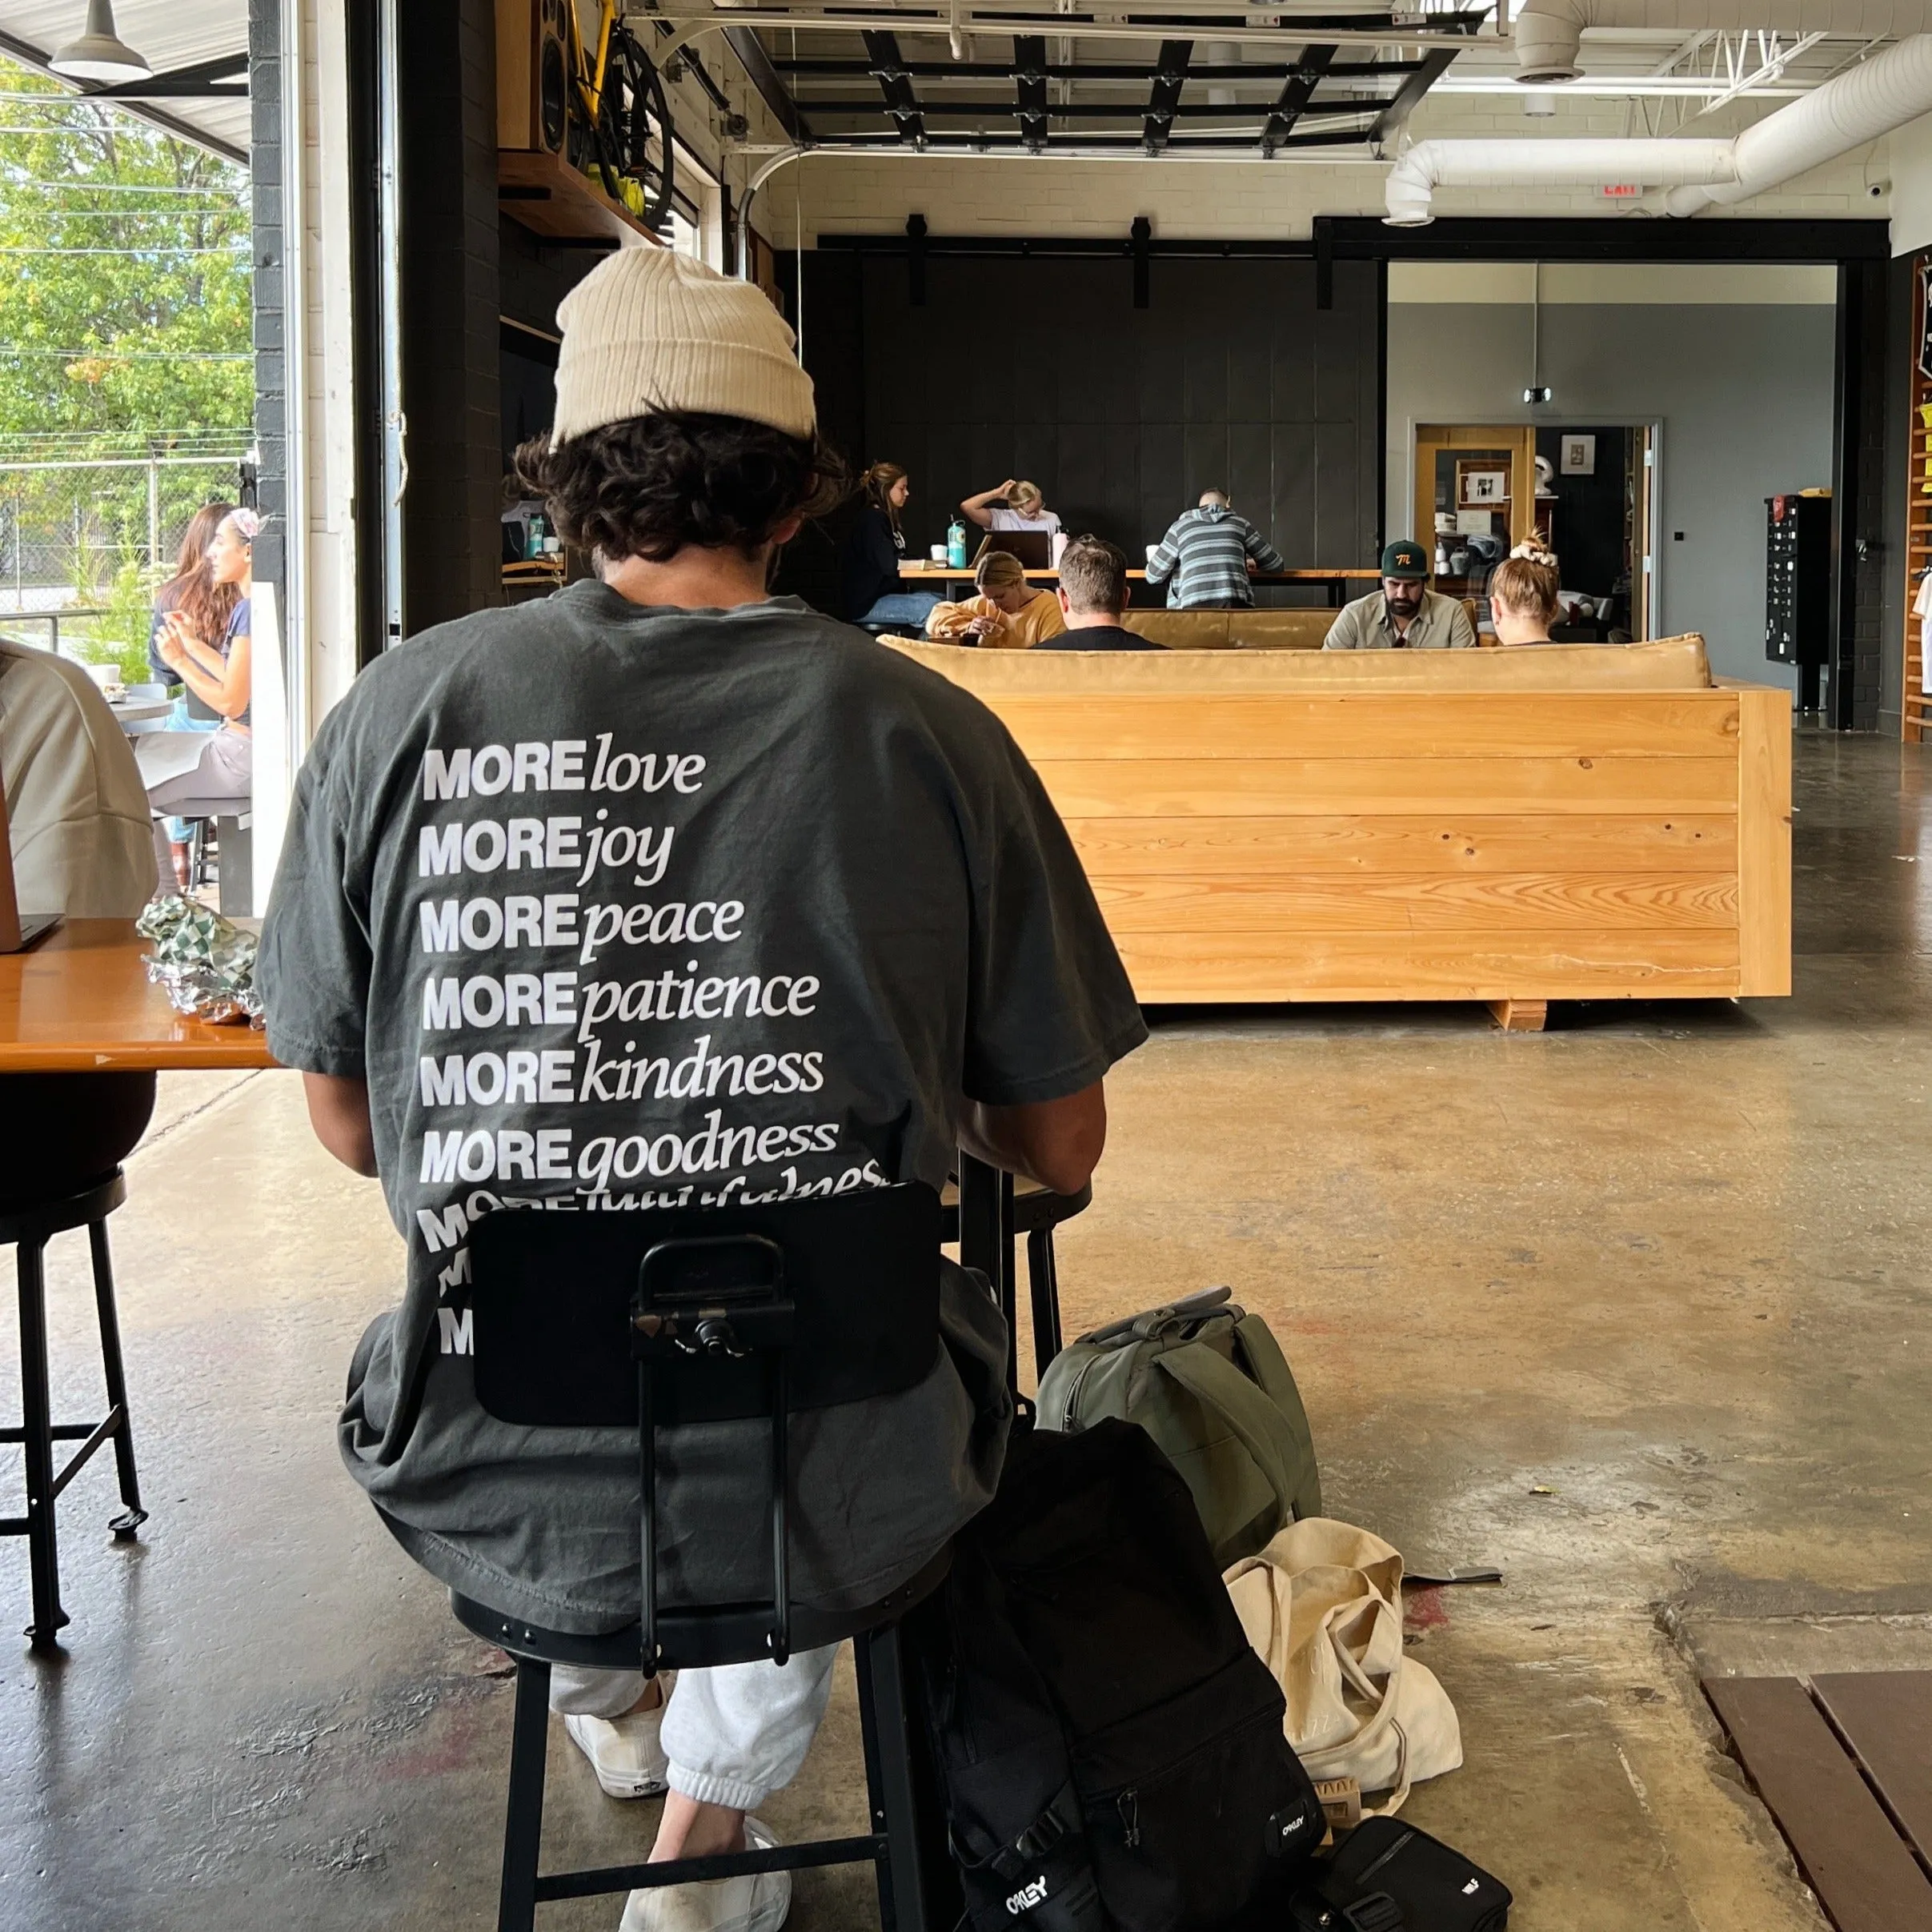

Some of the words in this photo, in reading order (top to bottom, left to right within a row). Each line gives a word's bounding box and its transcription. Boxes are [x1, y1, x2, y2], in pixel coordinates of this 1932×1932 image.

[423, 740, 587, 800] MORE
[589, 732, 706, 793] love
[418, 816, 582, 878] MORE
[575, 808, 675, 887] joy
[419, 893, 579, 954] MORE
[579, 900, 745, 966] peace
[423, 971, 578, 1030] MORE
[578, 960, 820, 1044] patience
[419, 1049, 575, 1107] MORE
[578, 1035, 824, 1103] kindness
[419, 1128, 572, 1183] MORE
[575, 1108, 840, 1194] goodness
